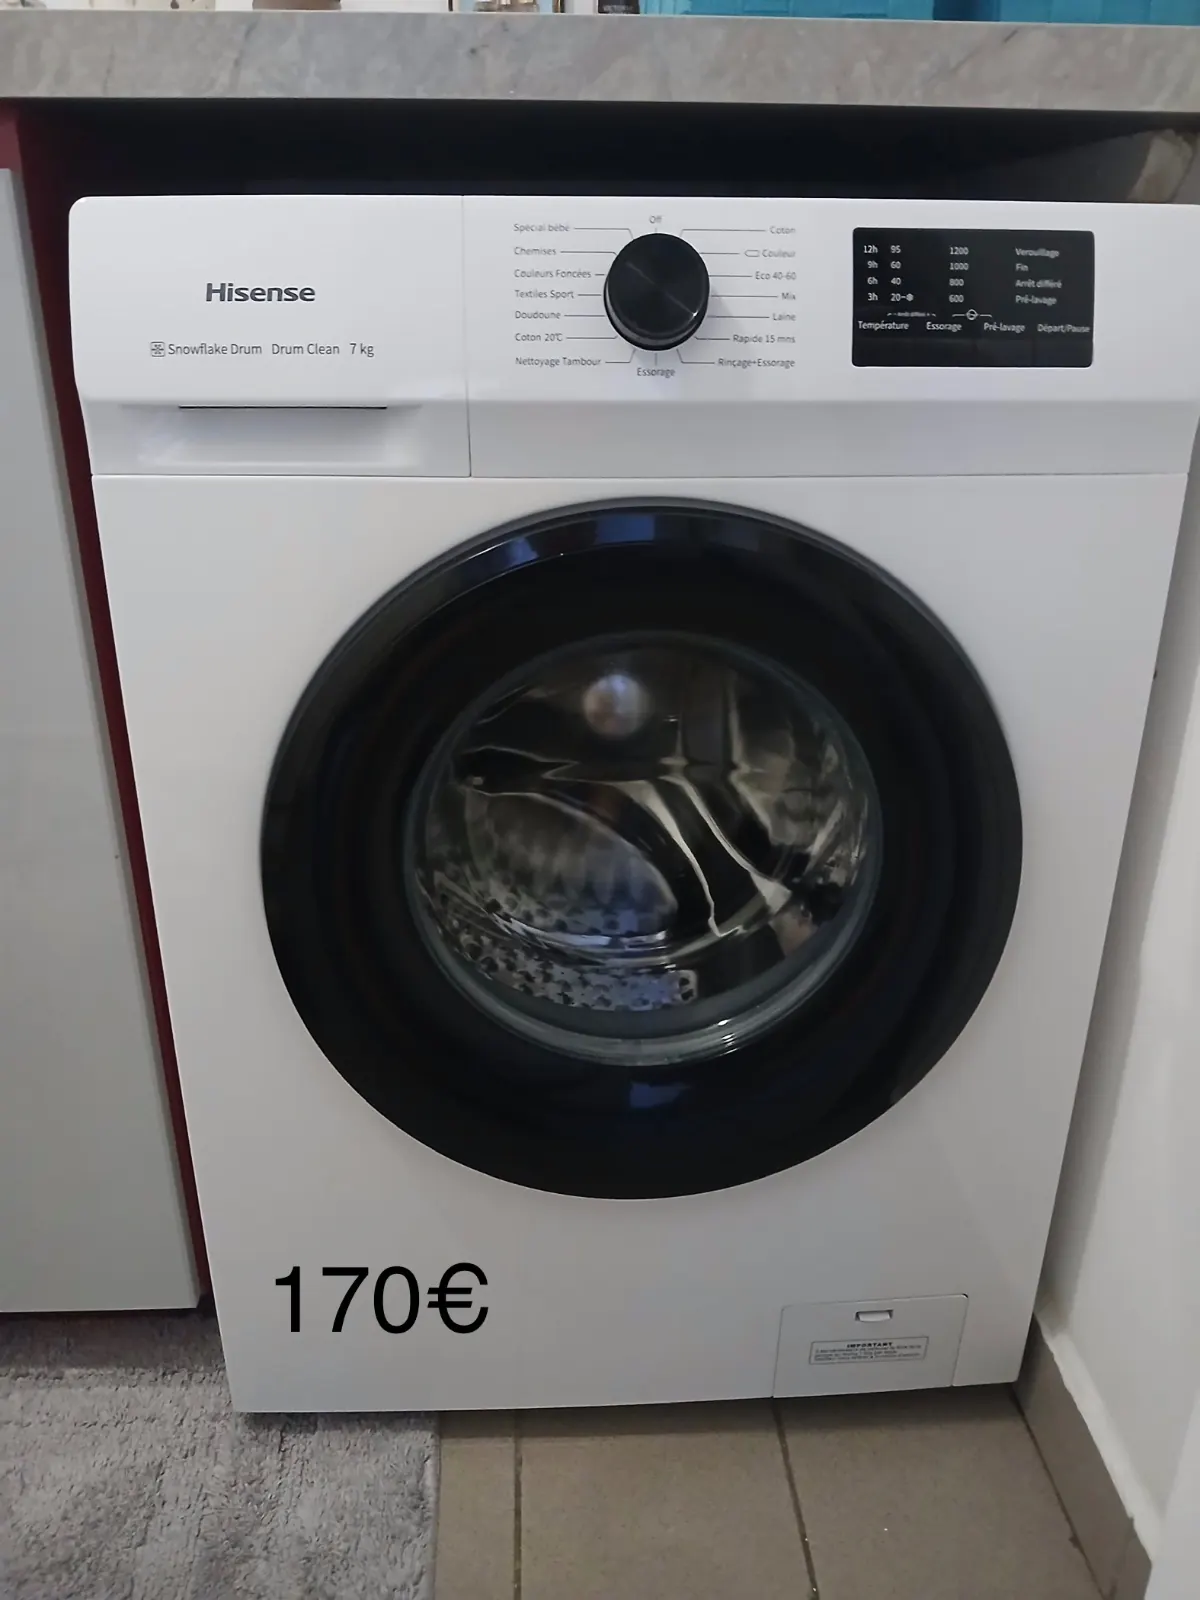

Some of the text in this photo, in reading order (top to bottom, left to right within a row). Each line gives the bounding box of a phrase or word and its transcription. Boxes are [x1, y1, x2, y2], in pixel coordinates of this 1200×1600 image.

[649, 215, 662, 223] Off
[770, 226, 796, 234] Coton
[514, 246, 556, 255] Chemises
[762, 249, 796, 258] Couleur
[864, 244, 878, 254] 12h
[890, 245, 902, 254] 95
[949, 246, 969, 256] 1200
[867, 260, 878, 268] 9h
[890, 261, 902, 269] 60
[949, 262, 969, 271] 1000
[1015, 262, 1029, 272] Fin
[514, 268, 592, 278] Couleurs Foncées
[755, 271, 797, 280] Eco 40-60
[867, 276, 878, 285] 6h
[890, 278, 902, 286] 40
[949, 278, 964, 287] 800
[206, 282, 316, 302] Hisense
[515, 290, 574, 300] Textiles Sport
[782, 292, 796, 300] Mix
[868, 292, 878, 301] 3h
[890, 293, 901, 302] 20
[949, 294, 964, 303] 600
[515, 310, 561, 320] Doudoune
[772, 313, 796, 322] Laine
[858, 320, 910, 331] Température
[926, 322, 962, 332] Essorage
[984, 322, 1026, 334] Pré-lavage
[515, 332, 542, 342] Coton
[732, 334, 796, 344] Rapide 15 mns
[168, 343, 375, 358] Snowflake Drum Drum Clean 7 kg
[515, 356, 601, 368] Nettoyage Tambour
[636, 368, 676, 378] Essorage
